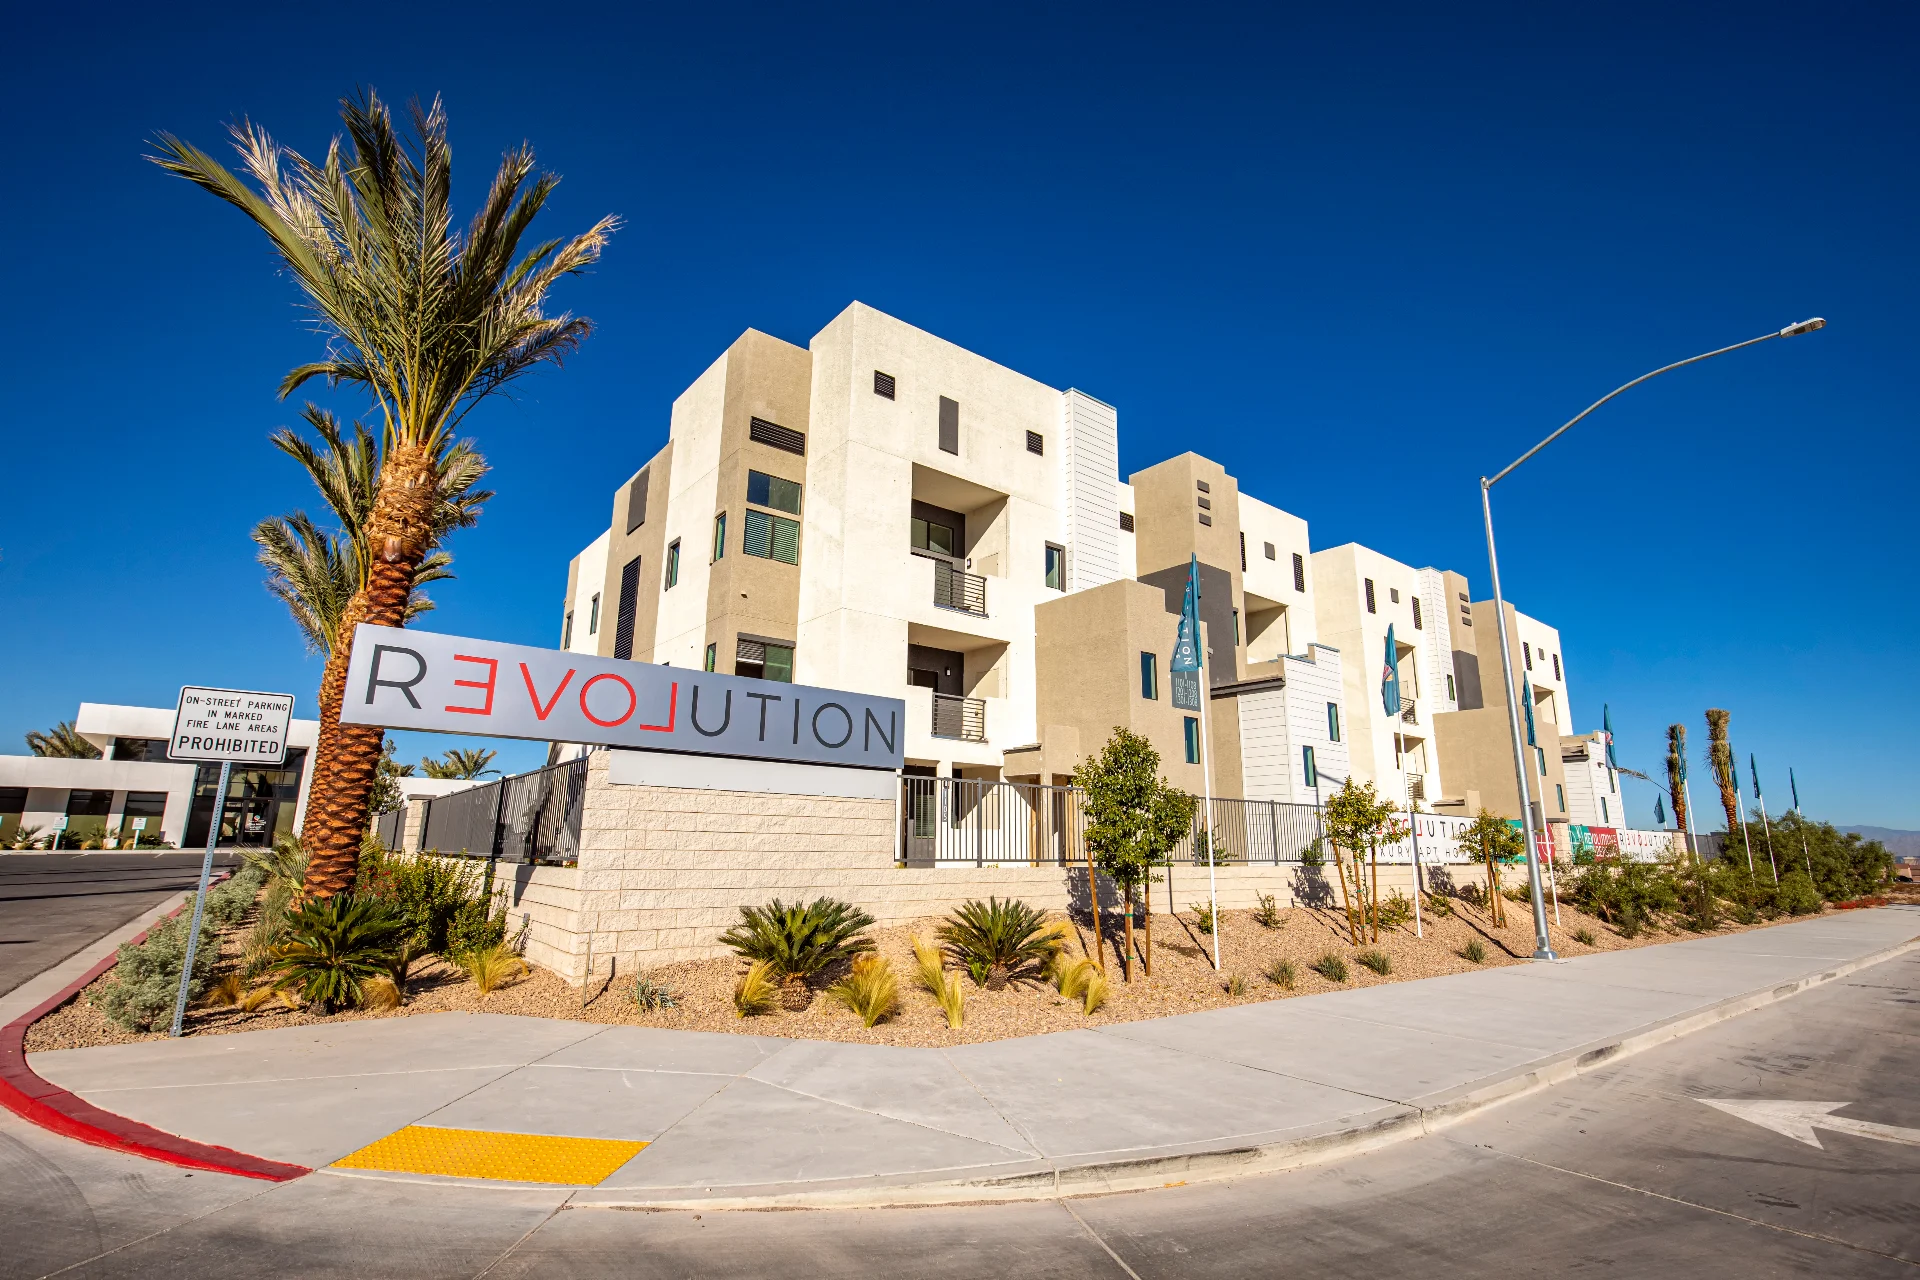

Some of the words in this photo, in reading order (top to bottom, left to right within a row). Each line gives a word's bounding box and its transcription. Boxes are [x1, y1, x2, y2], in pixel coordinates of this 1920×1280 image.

[186, 696, 241, 708] ON-STREET
[247, 701, 288, 711] PARKING
[365, 644, 897, 754] REVOLUTION
[207, 710, 217, 718] IN
[224, 711, 263, 721] MARKED
[186, 719, 209, 729] FIRE
[216, 722, 240, 731] LANE
[247, 724, 278, 733] AREAS
[178, 735, 279, 754] PROHIBITED
